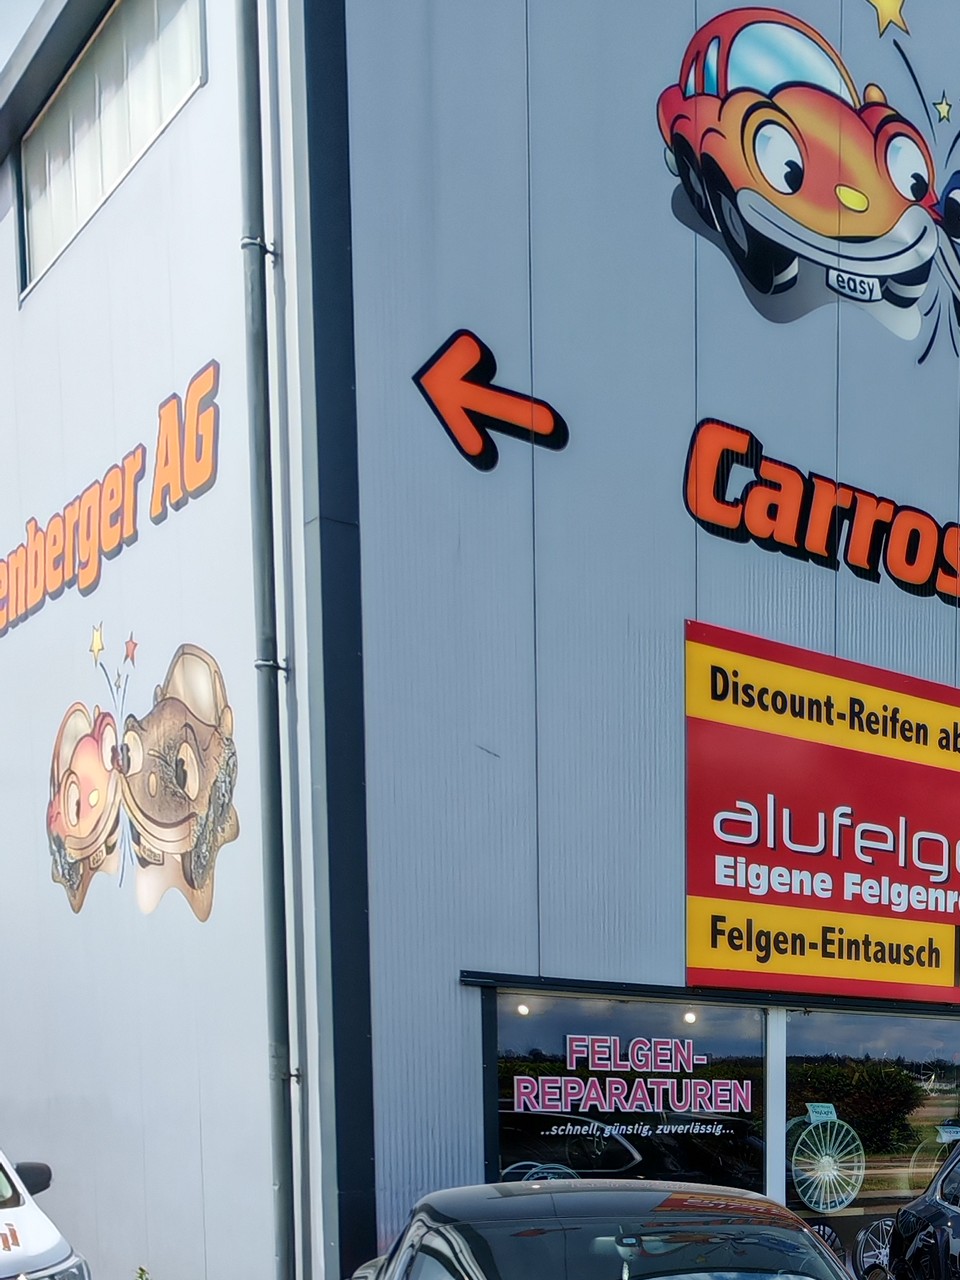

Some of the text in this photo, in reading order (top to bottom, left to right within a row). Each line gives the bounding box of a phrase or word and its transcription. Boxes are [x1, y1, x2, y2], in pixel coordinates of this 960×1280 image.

[836, 273, 875, 300] easy
[150, 359, 219, 525] AG
[709, 664, 929, 747] Discount-Reifen
[714, 855, 833, 899] Eigene
[710, 914, 941, 969] Felgen-Eintausch
[566, 1034, 707, 1073] FELGEN-
[513, 1076, 752, 1112] REPARATUREN
[603, 1123, 652, 1137] günstig,
